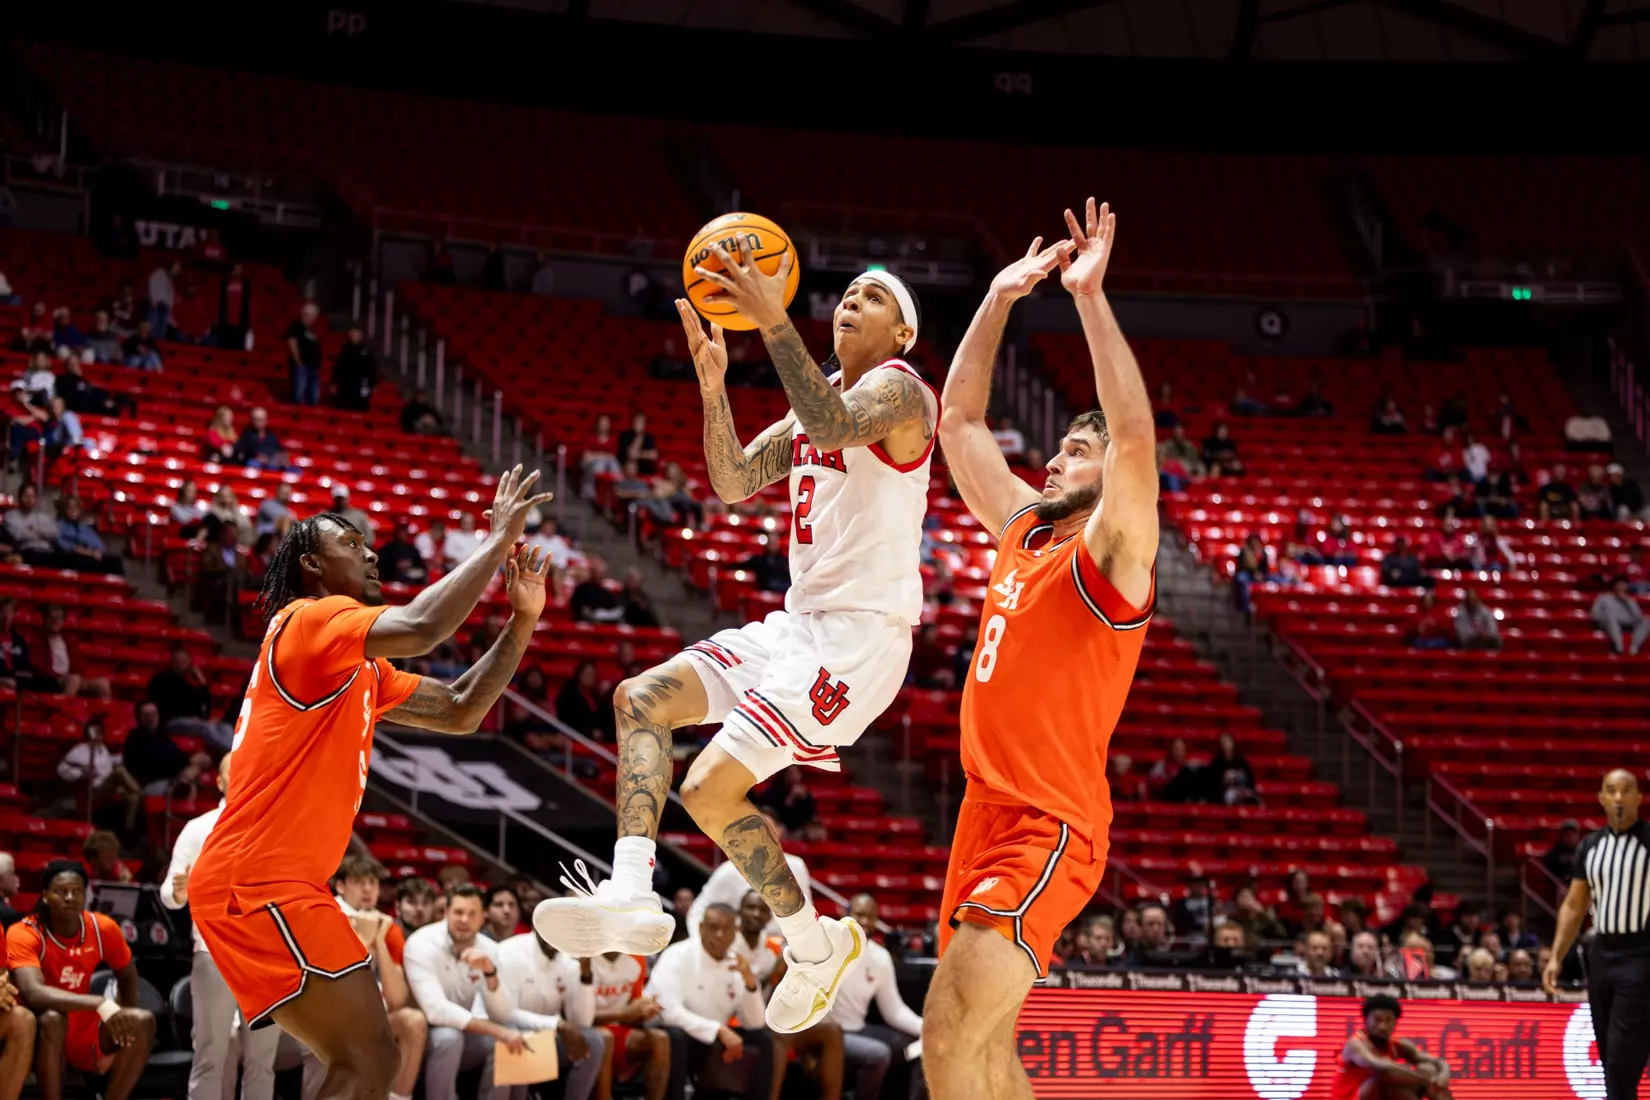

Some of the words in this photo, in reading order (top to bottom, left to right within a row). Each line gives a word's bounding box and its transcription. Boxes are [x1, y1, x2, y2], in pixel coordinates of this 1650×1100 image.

[133, 218, 208, 250] UTA
[792, 434, 847, 473] TAH
[795, 475, 815, 544] 2
[976, 614, 1007, 683] 8
[1017, 1030, 1076, 1078] en
[1093, 1011, 1215, 1079] Garff
